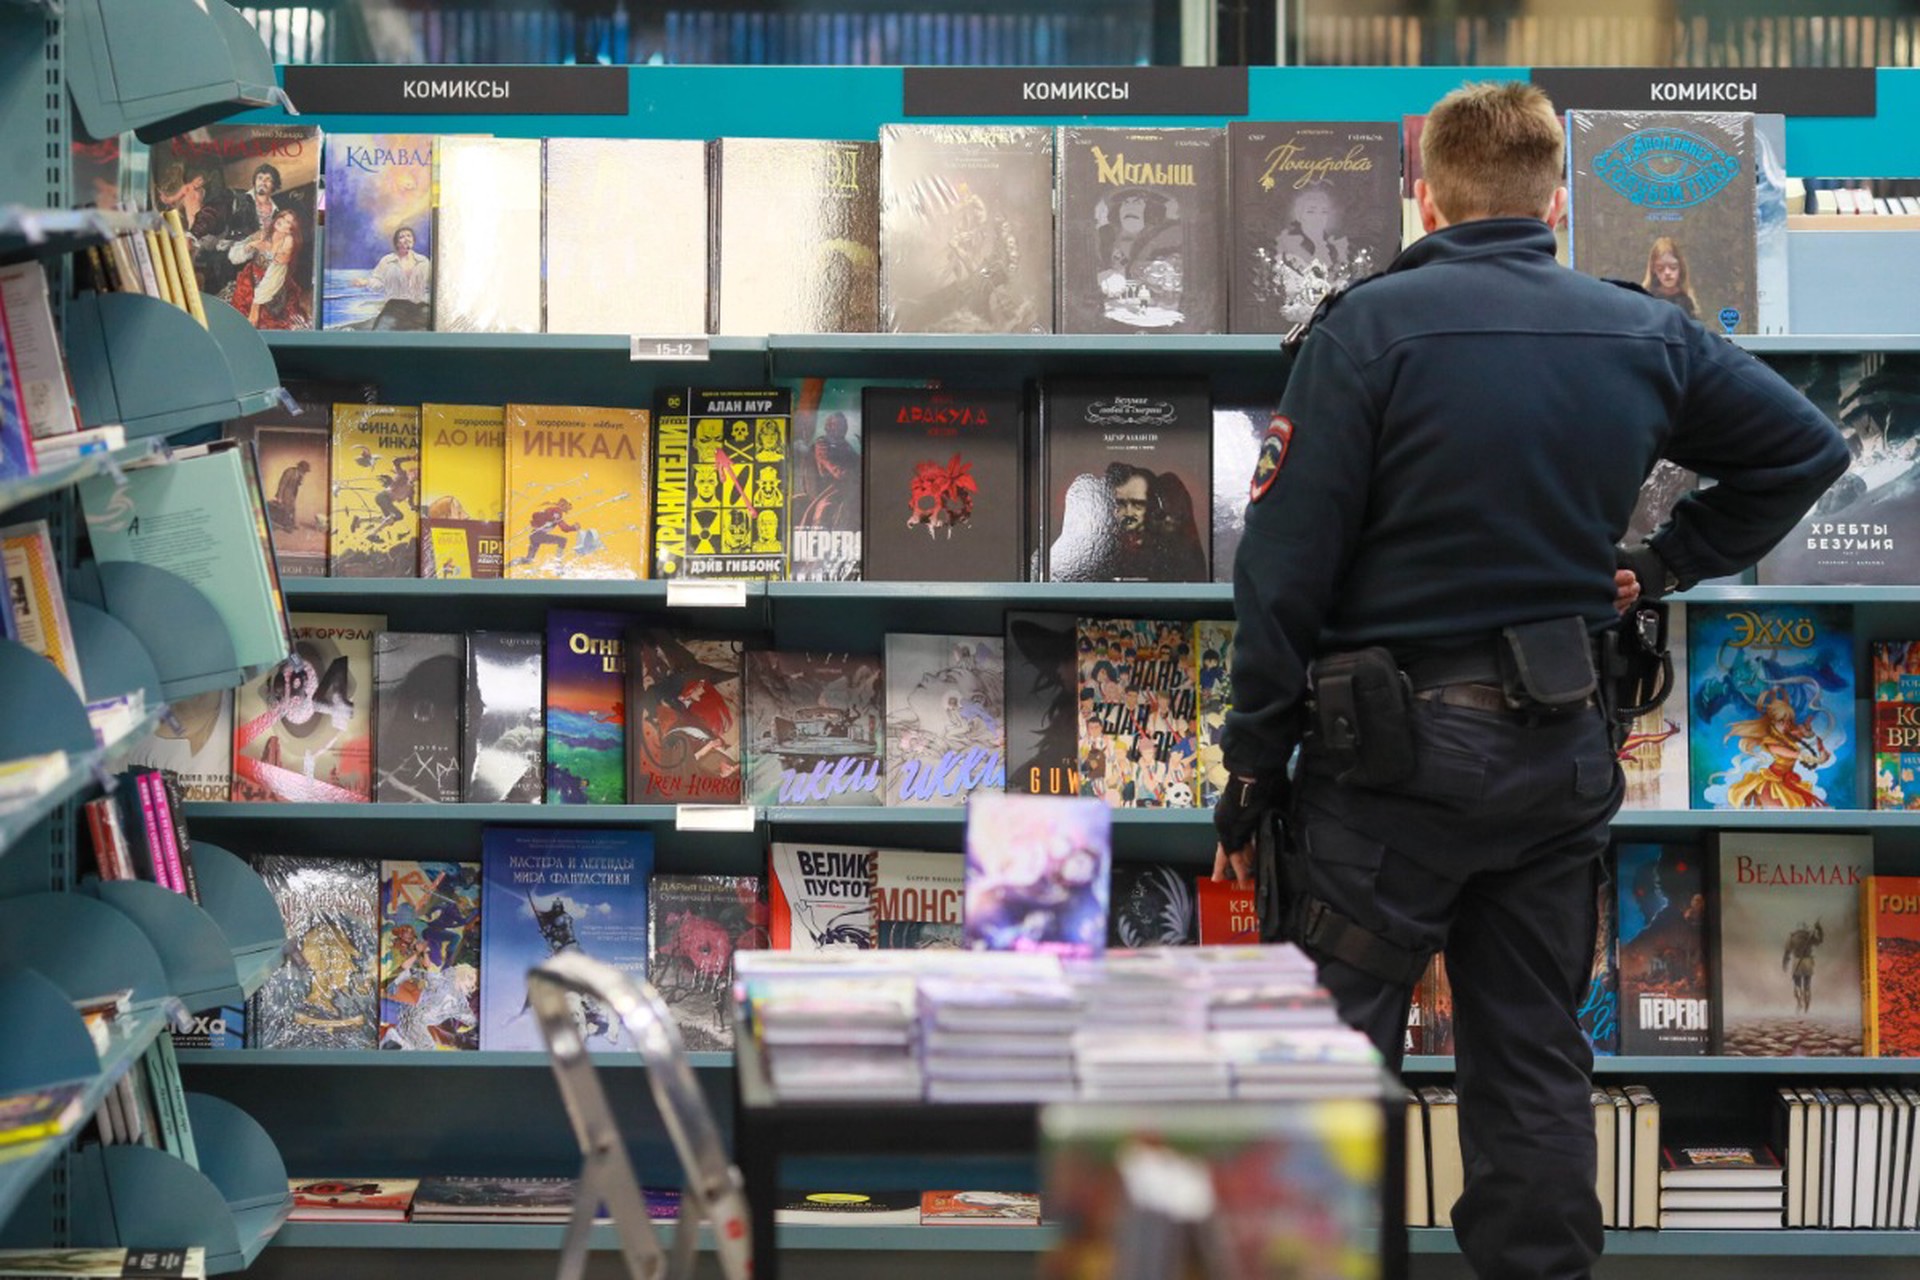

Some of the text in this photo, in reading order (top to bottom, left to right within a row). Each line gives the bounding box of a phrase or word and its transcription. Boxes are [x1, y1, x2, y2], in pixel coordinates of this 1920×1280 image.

[403, 81, 510, 98] КОМИКСЫ
[1022, 82, 1129, 100] КОМИКСЫ
[1650, 82, 1757, 101] КОМИКСЫ
[654, 343, 693, 355] 15-12
[707, 400, 773, 412] АЛАН МУР
[434, 429, 468, 447] ДО
[523, 430, 637, 461] ИНКАЛ
[1811, 523, 1888, 535] ХРЕБТЫ
[1806, 538, 1894, 550] БЕЗУМИЯ
[690, 558, 782, 573] ДЭЙВ ГИББОНС
[316, 627, 374, 641] ОРУЭЛЛ
[1131, 660, 1182, 691] НАНЬ
[509, 856, 635, 871] МАСТЕРА И ЛЕГЕНДЫ
[513, 871, 630, 885] МИРА ФАНТАСТИКИ
[1880, 894, 1920, 914] ГОН
